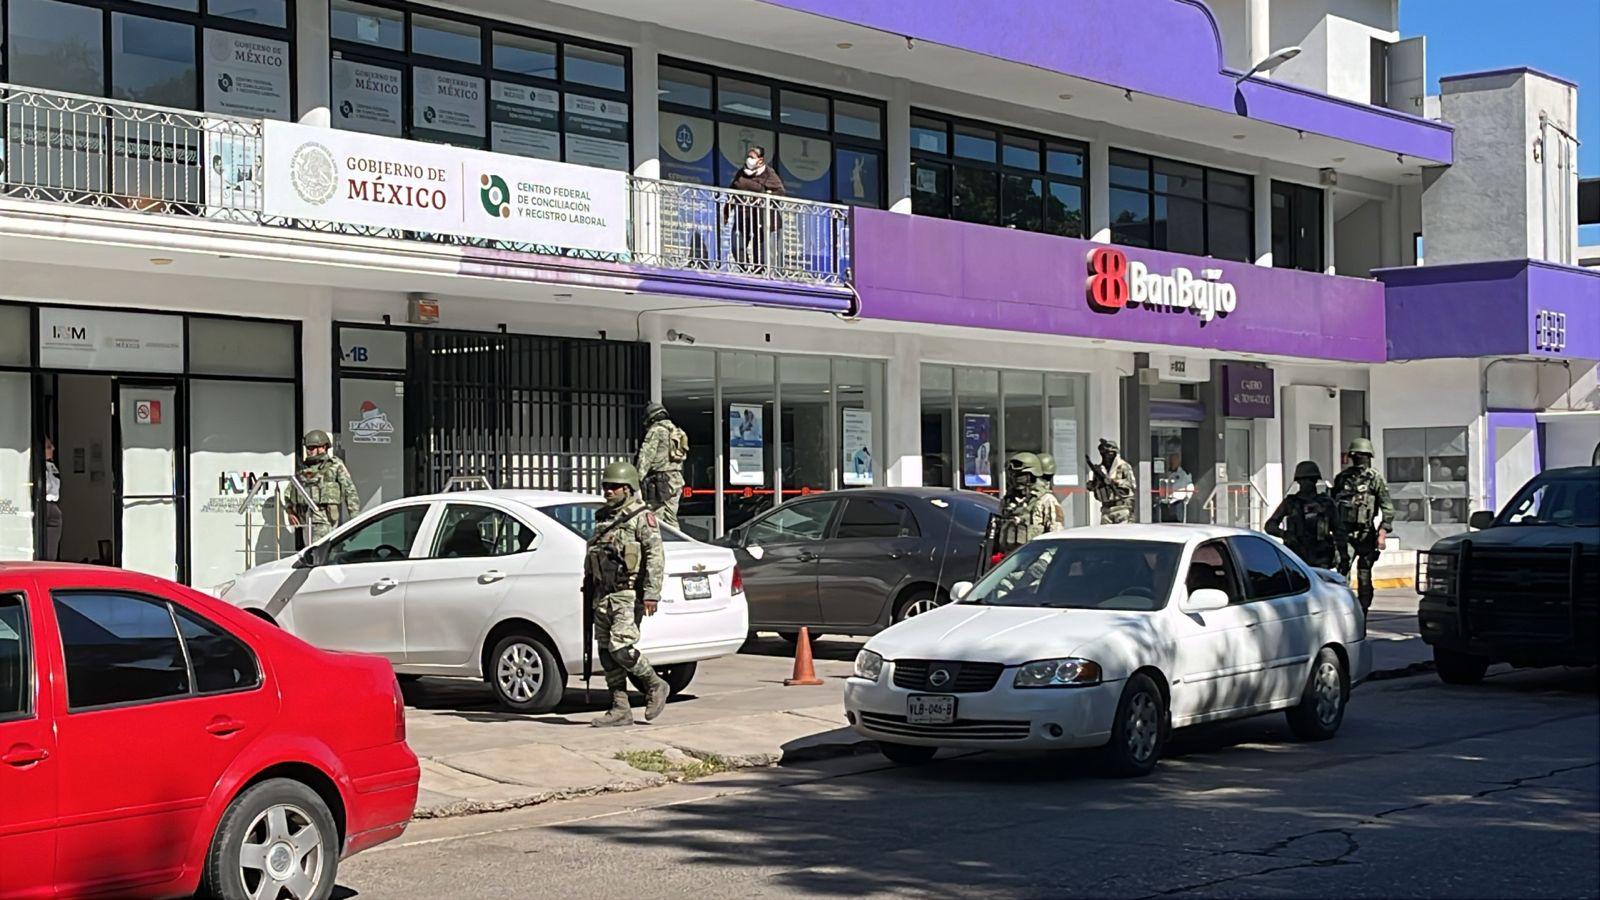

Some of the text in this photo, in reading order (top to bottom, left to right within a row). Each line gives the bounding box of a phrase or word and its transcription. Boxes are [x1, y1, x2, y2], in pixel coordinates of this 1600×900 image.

[234, 40, 271, 52] GOBIERNO
[235, 50, 282, 67] MÉXICO
[438, 84, 479, 100] MÉXICO
[346, 156, 446, 182] GOBIERNO DE
[347, 175, 447, 210] MÉXICO
[517, 182, 591, 201] CENTRO FEDERAL
[517, 195, 590, 212] DE CONCILIACIÓN
[517, 207, 607, 227] Y REGISTRO LABORAL
